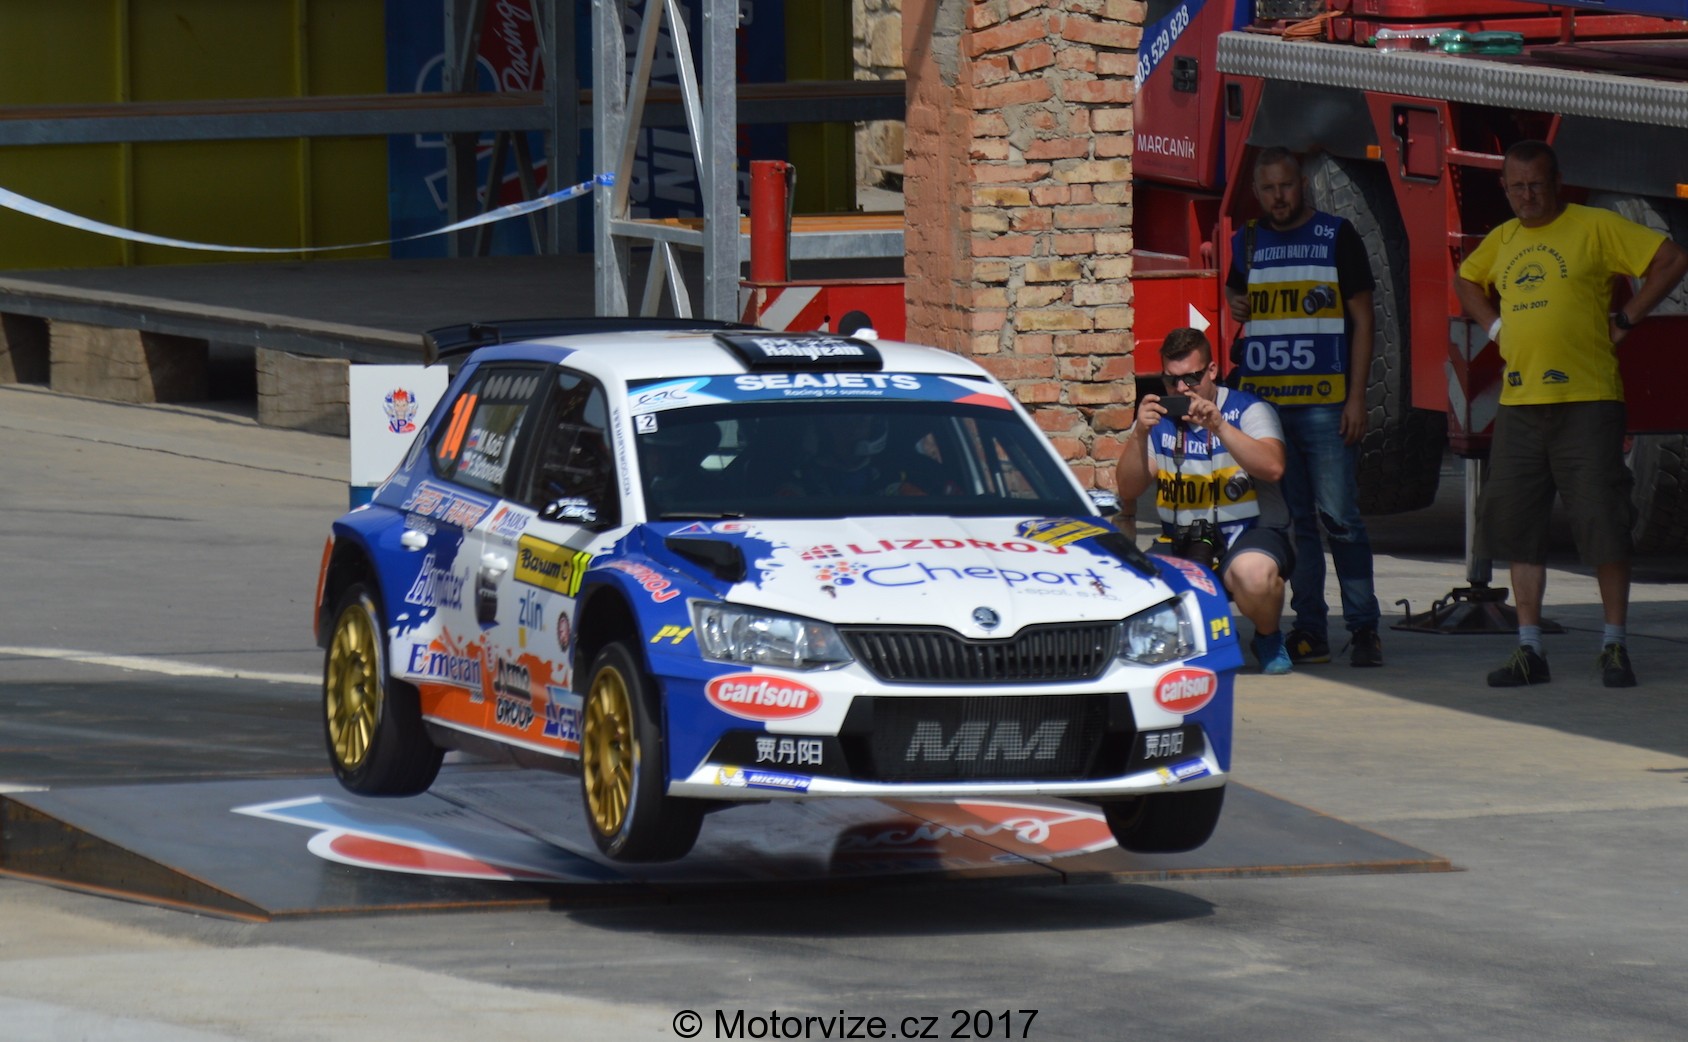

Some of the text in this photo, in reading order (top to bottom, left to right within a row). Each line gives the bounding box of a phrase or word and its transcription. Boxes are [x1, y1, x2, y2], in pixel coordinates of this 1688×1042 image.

[1151, 29, 1170, 64] 529
[1170, 5, 1189, 41] 828
[1265, 246, 1286, 261] CZECH
[1287, 244, 1310, 259] RALLY
[1280, 289, 1299, 312] TV
[1530, 300, 1549, 309] 2017
[1246, 339, 1316, 372] 055
[734, 373, 922, 392] SEAJETS
[826, 388, 836, 396] to
[840, 389, 884, 397] summer
[439, 393, 478, 460] 11
[521, 547, 563, 580] Barum
[862, 562, 1112, 589] Cheport
[650, 624, 694, 645] P1
[407, 643, 482, 684] Emeran
[718, 680, 809, 709] carlson
[1161, 675, 1210, 702] carlson
[756, 737, 823, 765] 贾丹阳
[904, 721, 1070, 762] MM
[749, 775, 810, 788] MICHELIN
